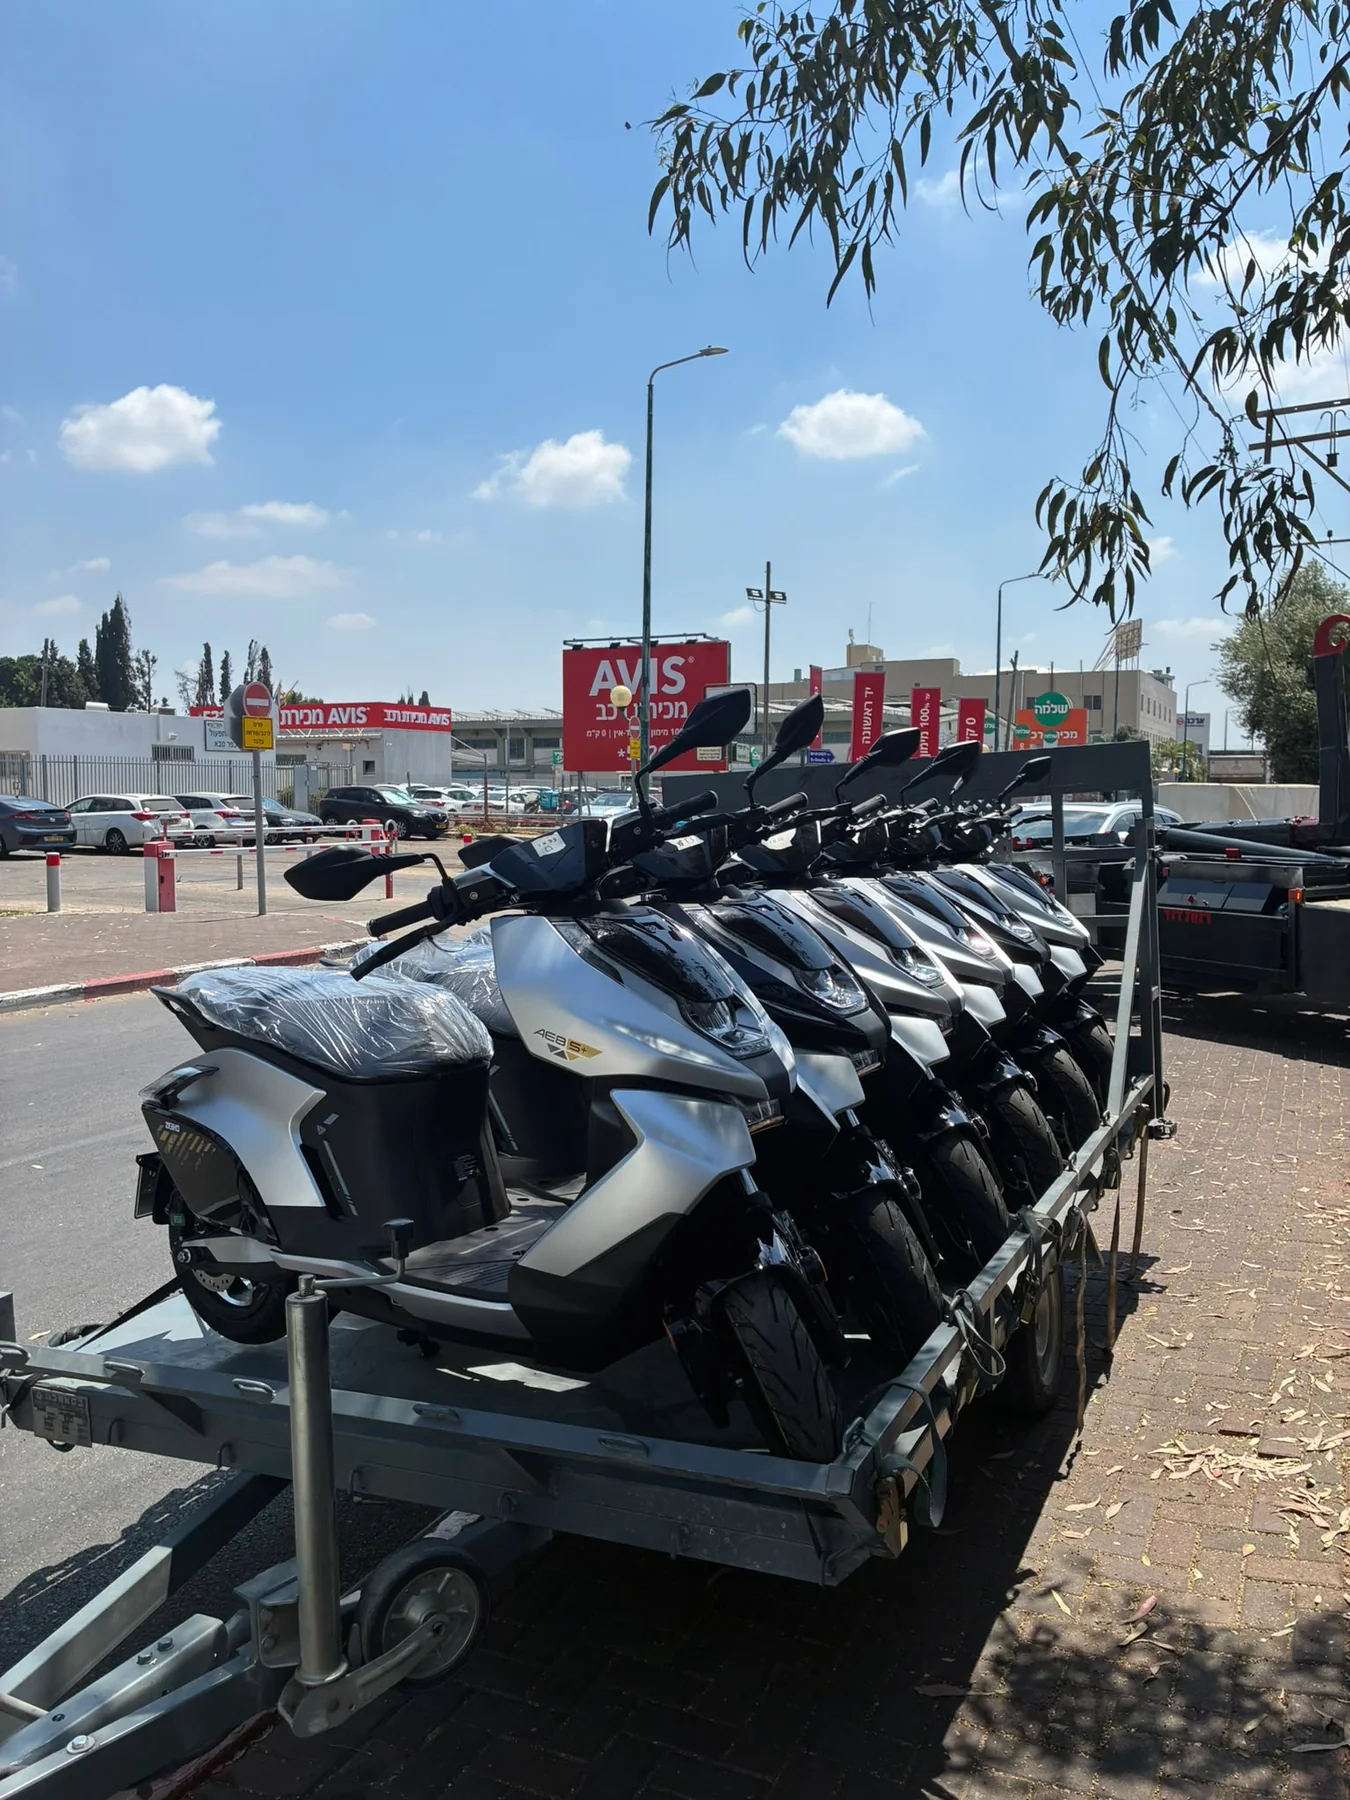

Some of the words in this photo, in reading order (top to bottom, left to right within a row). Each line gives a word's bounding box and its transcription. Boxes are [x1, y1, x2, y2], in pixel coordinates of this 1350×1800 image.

[864, 686, 874, 698] יד
[279, 708, 324, 726] מכירת
[328, 706, 368, 725] AVIS
[1034, 702, 1068, 715] שלמה
[862, 701, 873, 744] ראשונה
